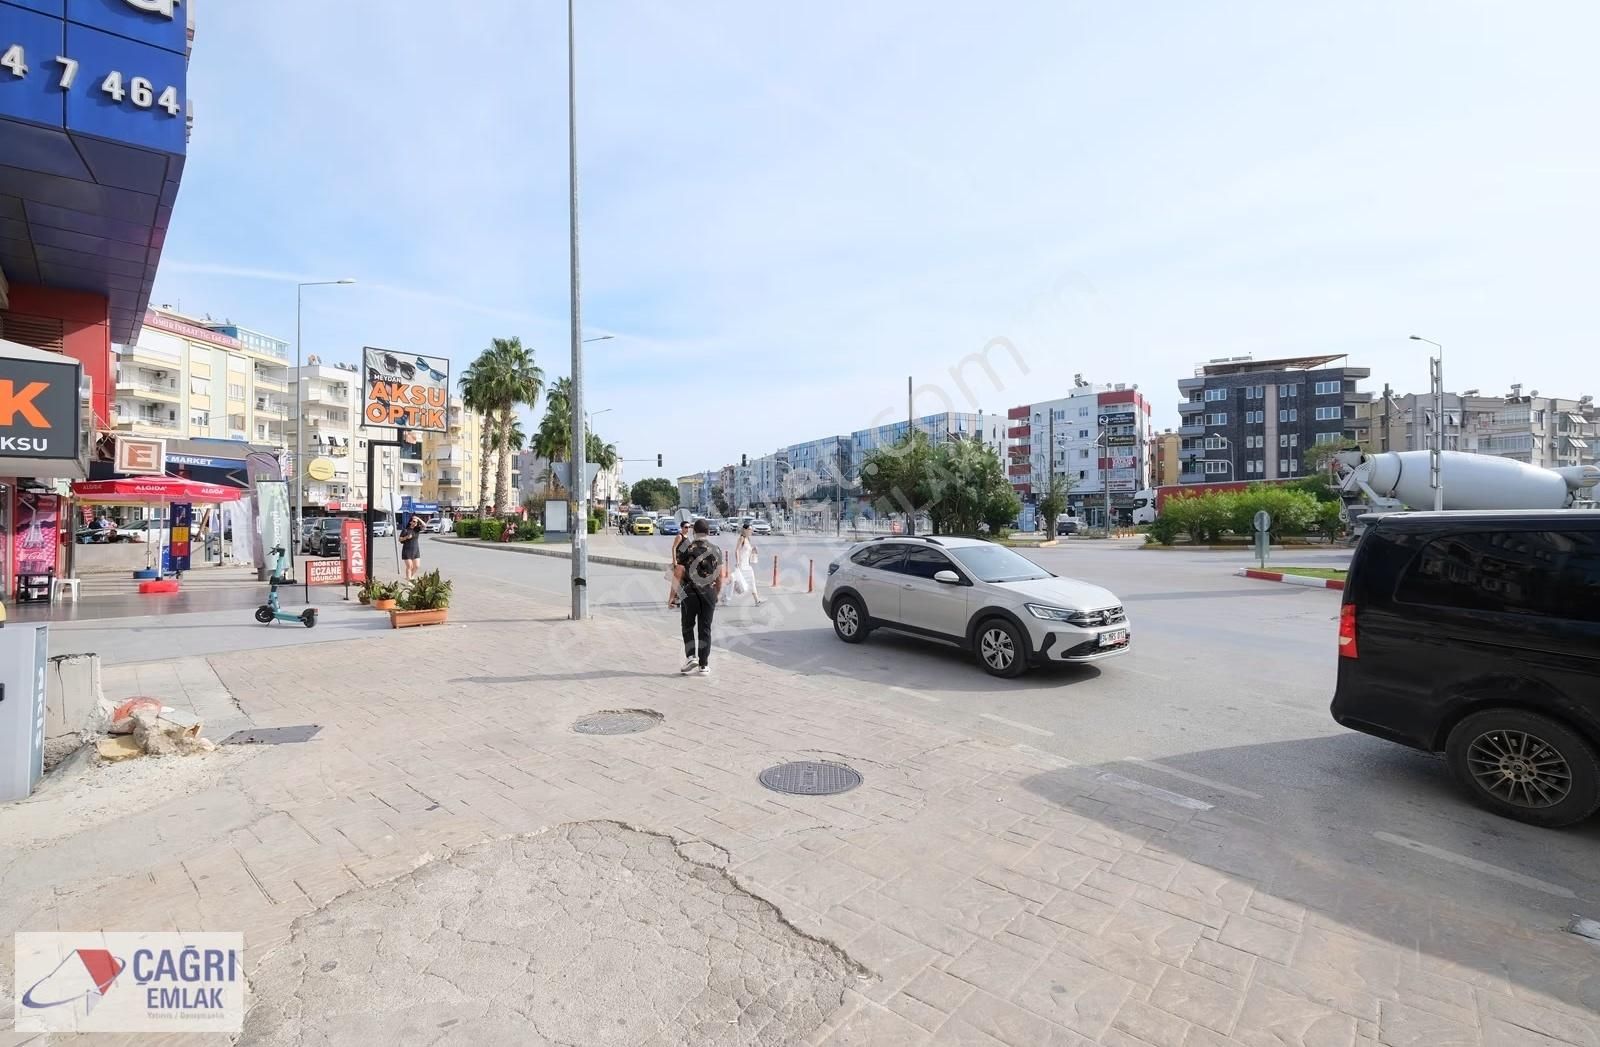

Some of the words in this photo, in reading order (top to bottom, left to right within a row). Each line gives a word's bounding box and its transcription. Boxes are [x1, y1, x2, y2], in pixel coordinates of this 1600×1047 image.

[56, 55, 78, 89] 7
[102, 70, 180, 116] 464
[374, 374, 401, 383] MEYDAN
[369, 381, 445, 408] AKSU
[366, 402, 445, 429] OPTİK
[170, 456, 213, 466] MARKET
[135, 484, 166, 492] ALGIDA
[201, 487, 225, 495] ALGIDA
[351, 528, 364, 574] ECZANE
[311, 566, 342, 576] ECZANE
